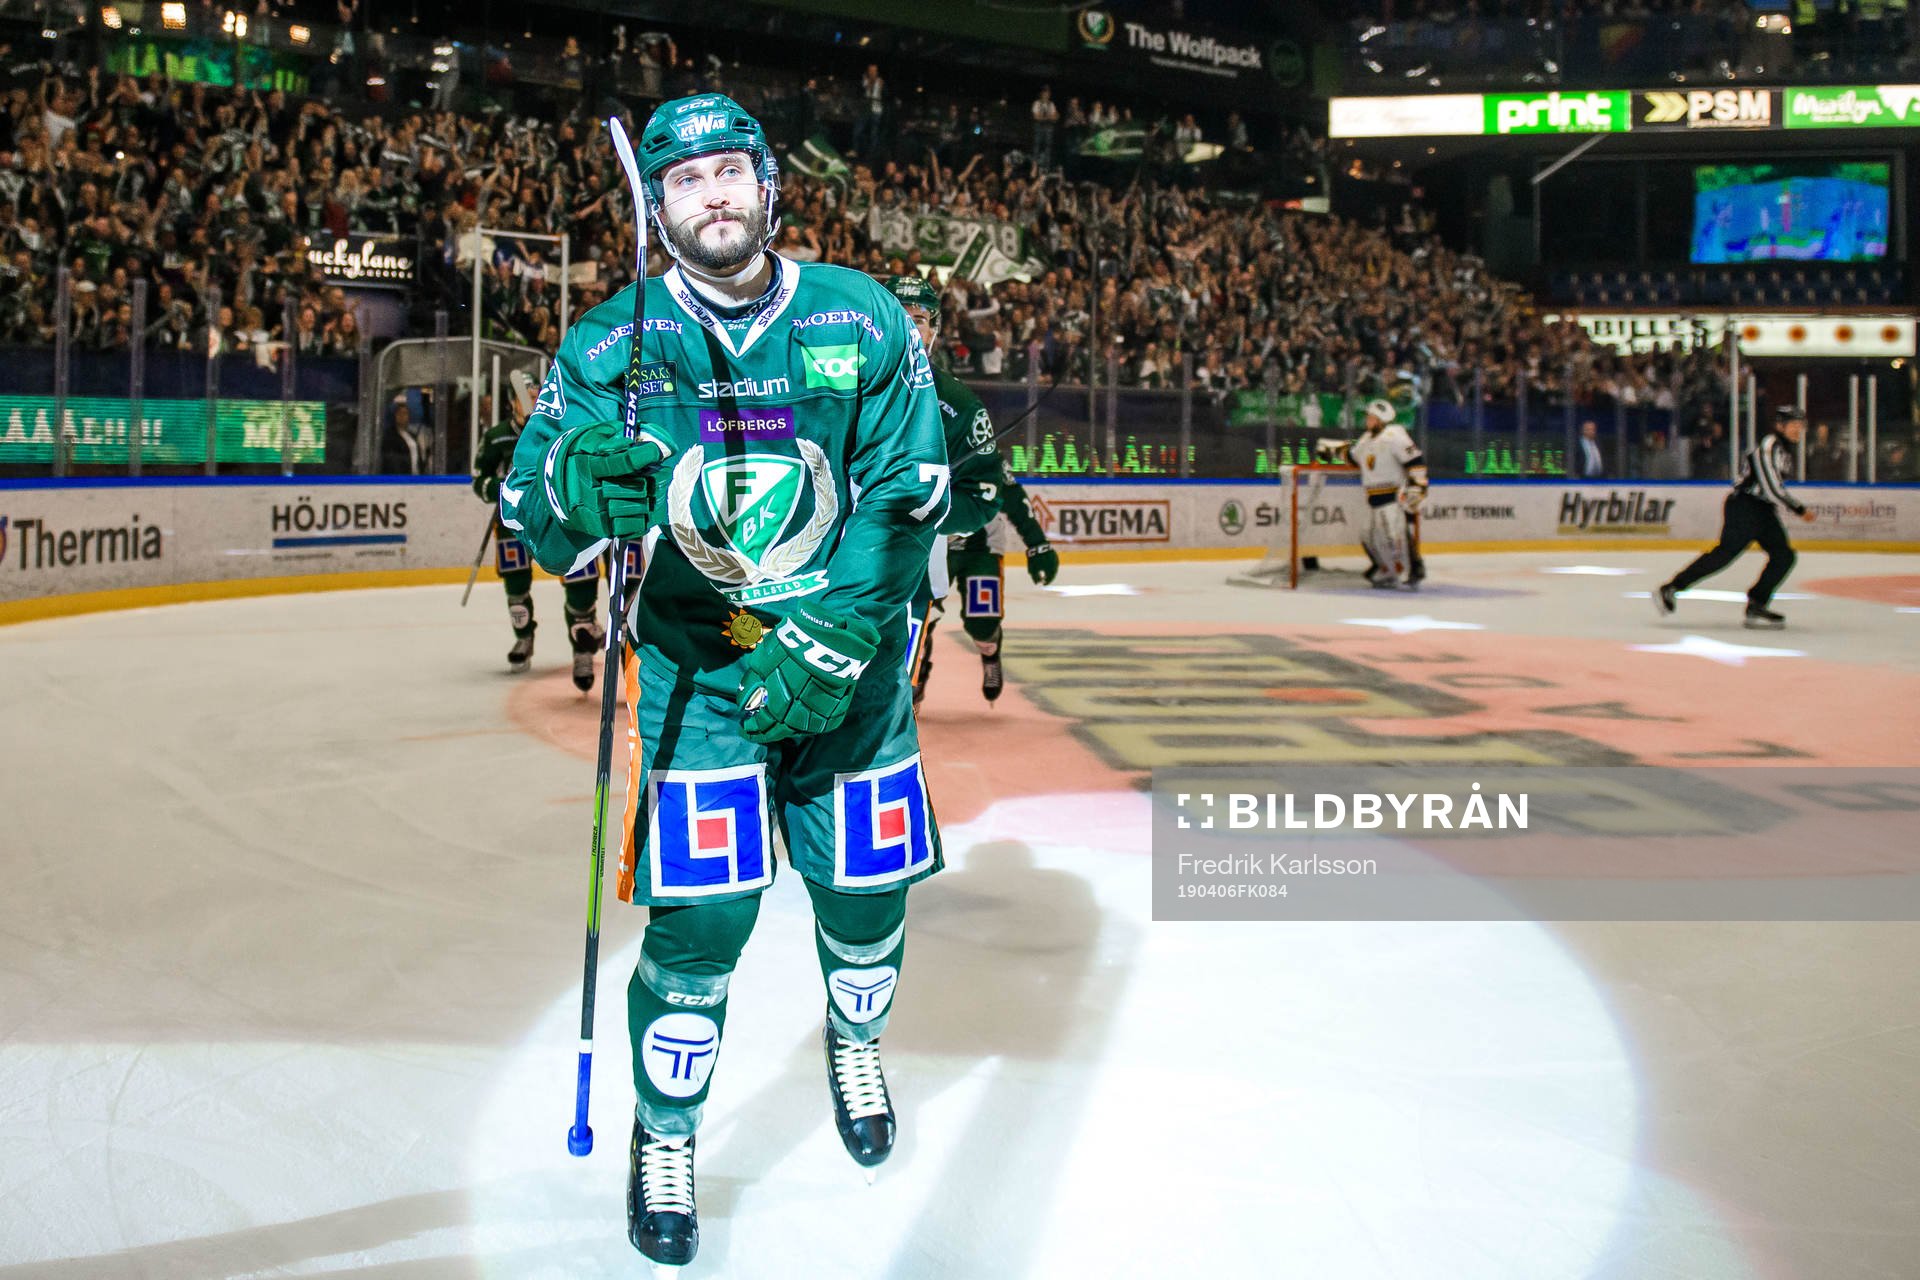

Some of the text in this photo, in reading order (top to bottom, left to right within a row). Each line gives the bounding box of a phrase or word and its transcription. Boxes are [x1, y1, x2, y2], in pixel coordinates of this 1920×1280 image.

[1124, 22, 1165, 50] The
[1168, 31, 1262, 69] Wolfpack
[676, 99, 716, 114] CCM
[1497, 92, 1611, 133] print
[1687, 90, 1770, 121] PSM
[681, 114, 726, 138] KEWAB
[303, 236, 413, 279] uckylane
[677, 289, 717, 328] stadium
[758, 287, 790, 327] stadium
[727, 323, 748, 331] SHL
[792, 310, 884, 342] MOELVEN
[813, 357, 859, 378] COO
[698, 377, 790, 399] stadium
[707, 418, 787, 432] LÖFBERGS
[908, 463, 950, 522] 7
[1560, 490, 1675, 529] Hyrbilar
[272, 496, 407, 533] HÖJDENS
[742, 493, 776, 545] BK
[1059, 508, 1165, 536] BYGMA
[13, 514, 162, 571] Thermia
[728, 580, 801, 600] KARLSTAD
[776, 617, 871, 681] CCM
[666, 991, 718, 1007] CCM
